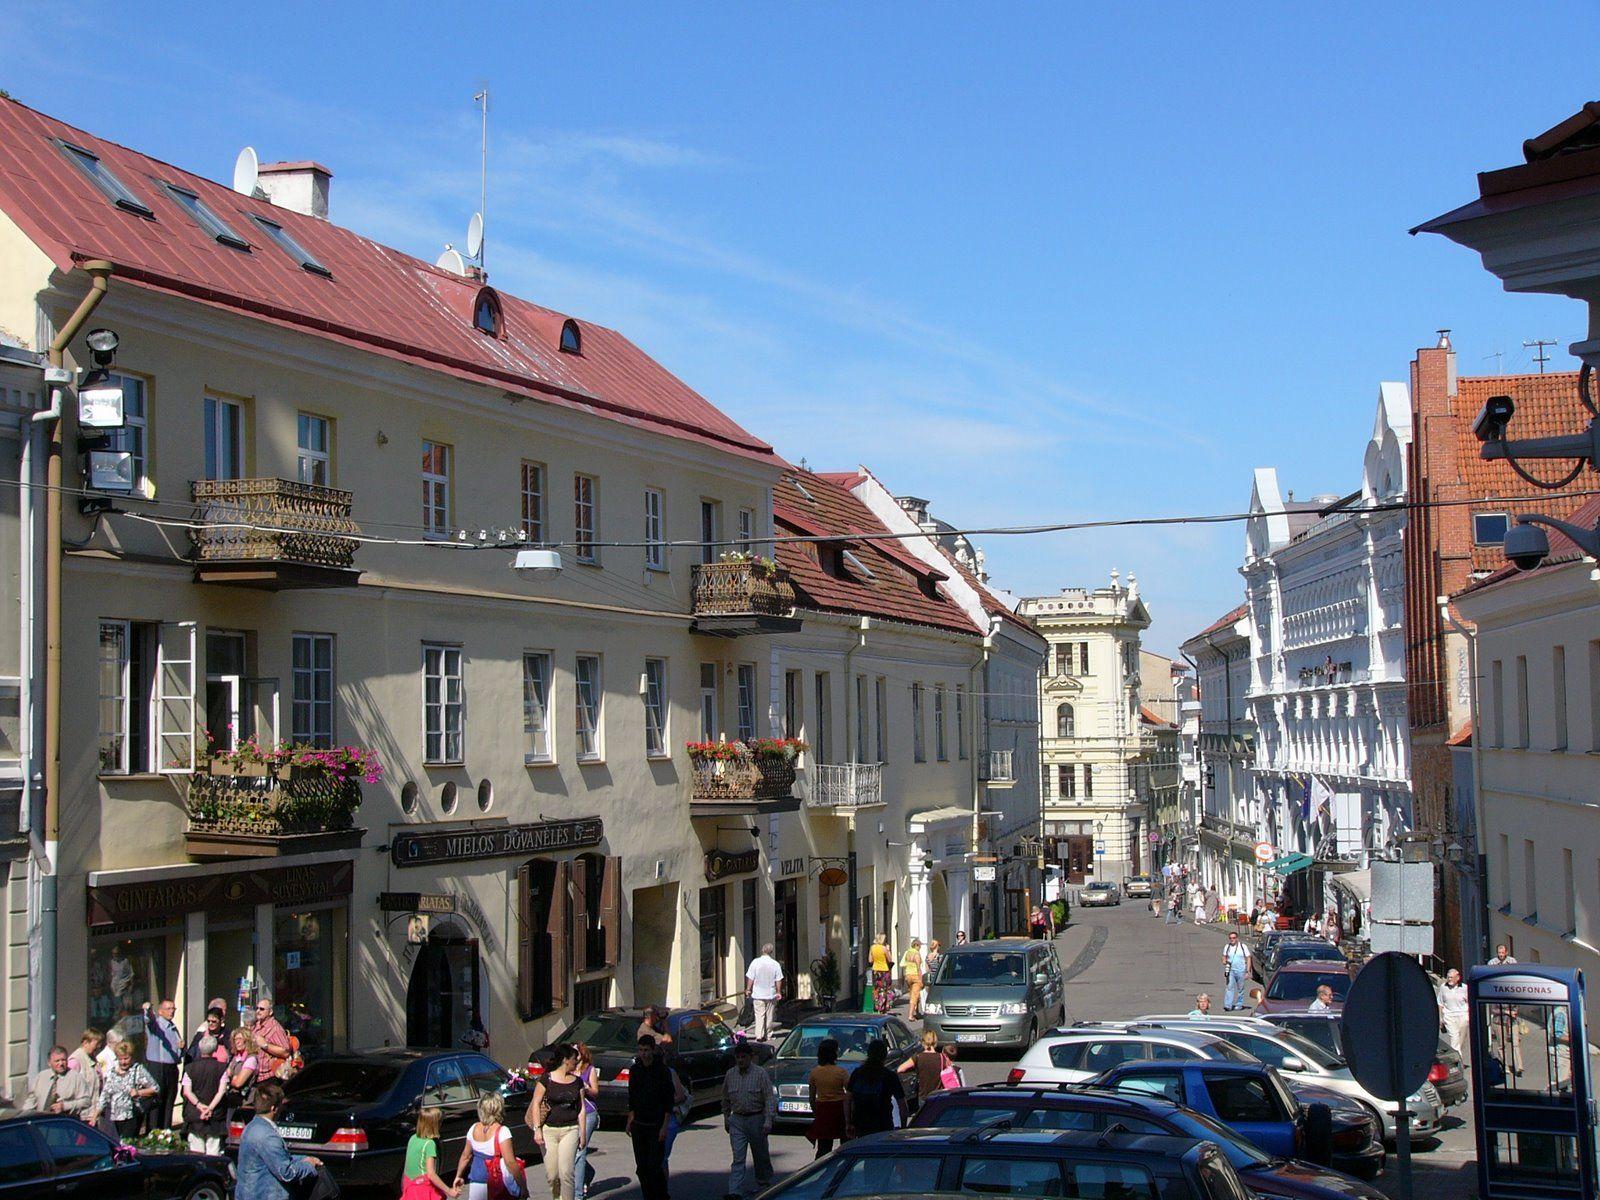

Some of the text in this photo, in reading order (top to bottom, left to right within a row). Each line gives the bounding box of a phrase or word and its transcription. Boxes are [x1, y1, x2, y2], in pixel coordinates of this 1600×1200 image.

[445, 834, 495, 857] MIELOS
[780, 858, 804, 875] VELITA
[117, 884, 197, 912] GINTARAS
[1494, 985, 1552, 994] TAKSOFONAS
